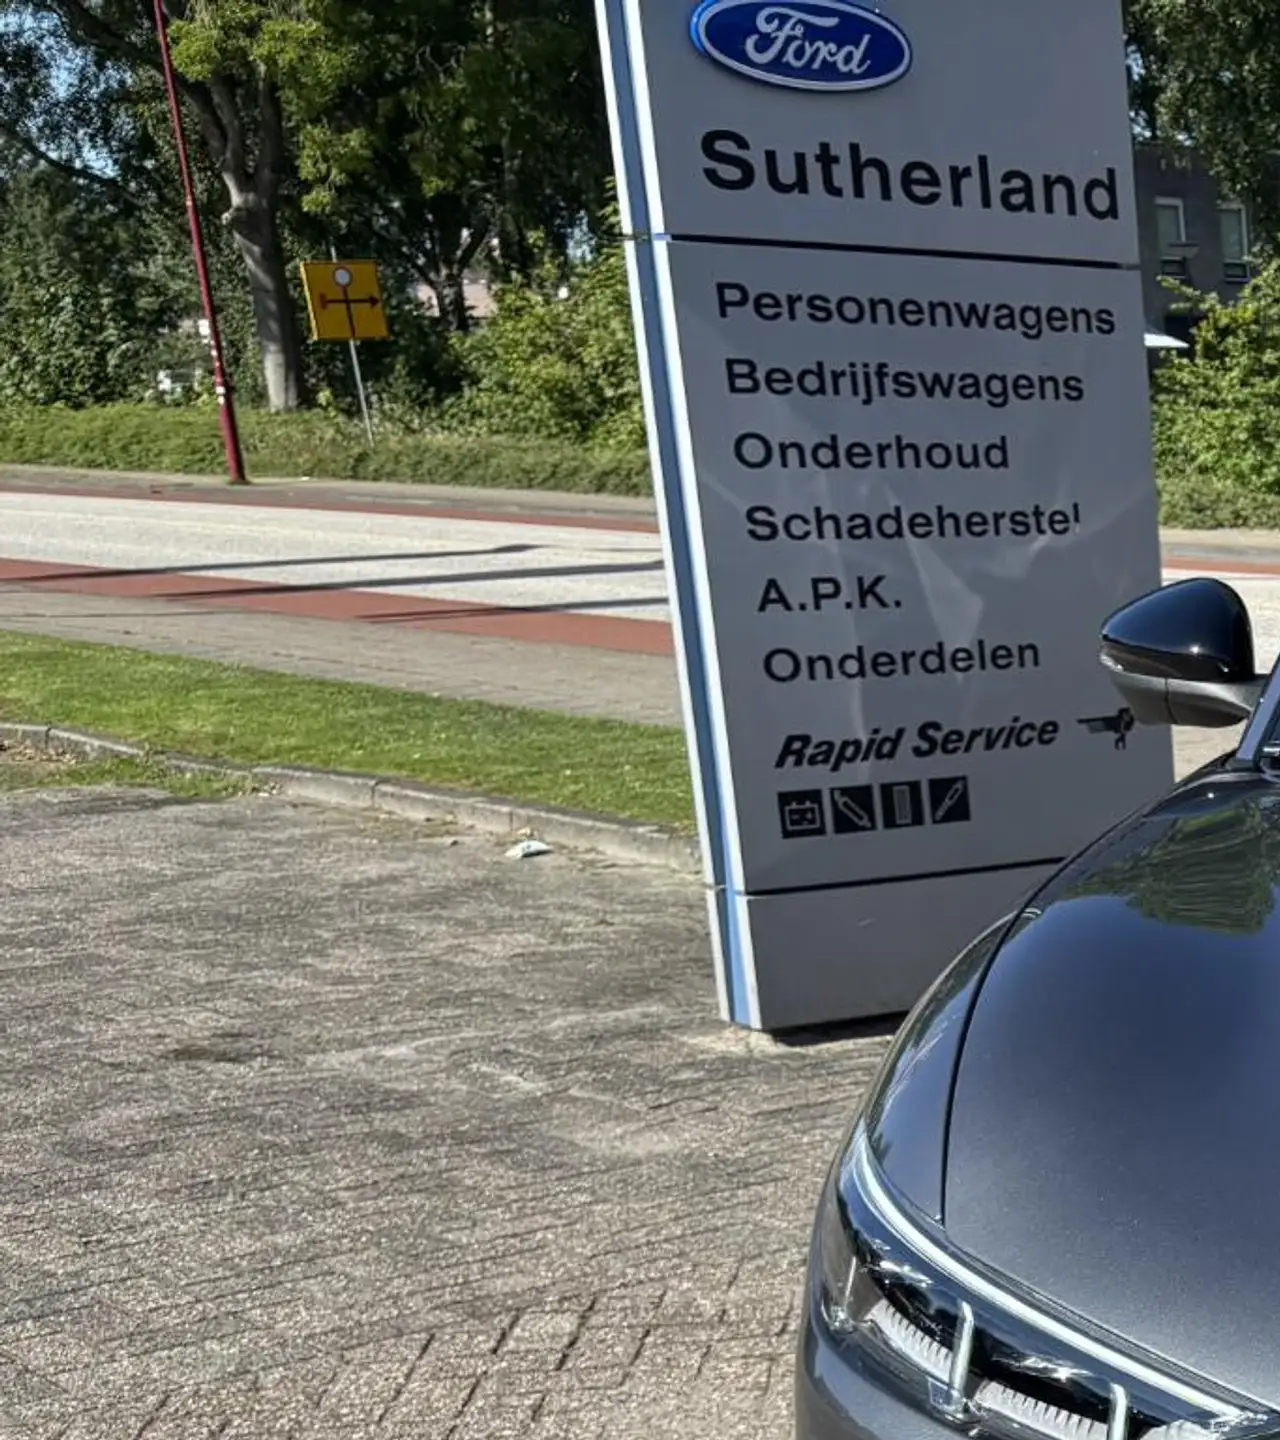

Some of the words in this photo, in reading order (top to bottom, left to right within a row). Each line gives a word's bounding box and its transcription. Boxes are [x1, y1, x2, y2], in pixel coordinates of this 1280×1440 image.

[744, 6, 872, 76] Ford
[700, 128, 1120, 221] Sutherland
[715, 281, 1116, 340] Personenwagens
[725, 357, 1085, 408] Bedrijfswagens
[732, 431, 1010, 470] Onderhoud
[756, 574, 902, 614] A.P.K.
[762, 637, 1041, 683] Onderdelen
[774, 727, 905, 773] Rapid
[912, 715, 1059, 759] Service
